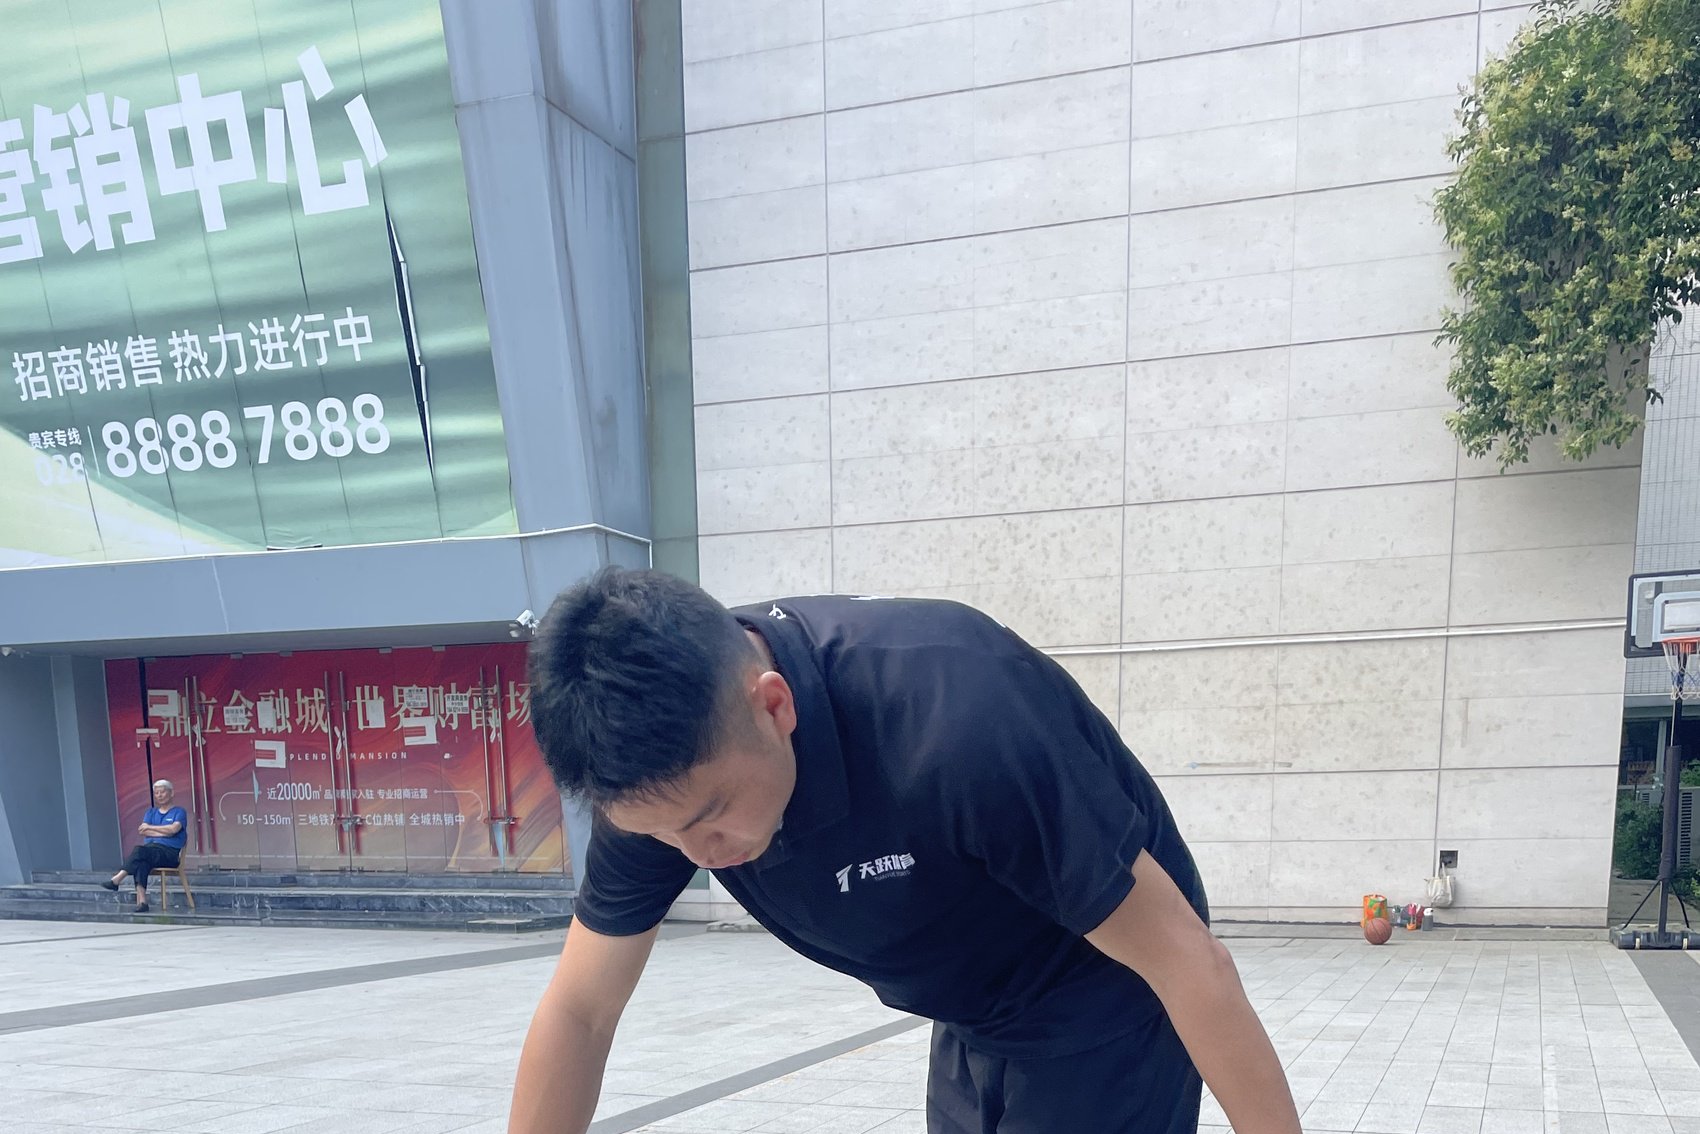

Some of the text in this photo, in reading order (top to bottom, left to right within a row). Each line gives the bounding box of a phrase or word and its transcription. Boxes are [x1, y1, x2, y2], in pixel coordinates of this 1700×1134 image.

[12, 306, 374, 402] 招商销售 热力进行中
[28, 427, 82, 449] 贵宾专线
[34, 393, 391, 487] 028 8888 7888
[409, 812, 465, 826] 全城热销中
